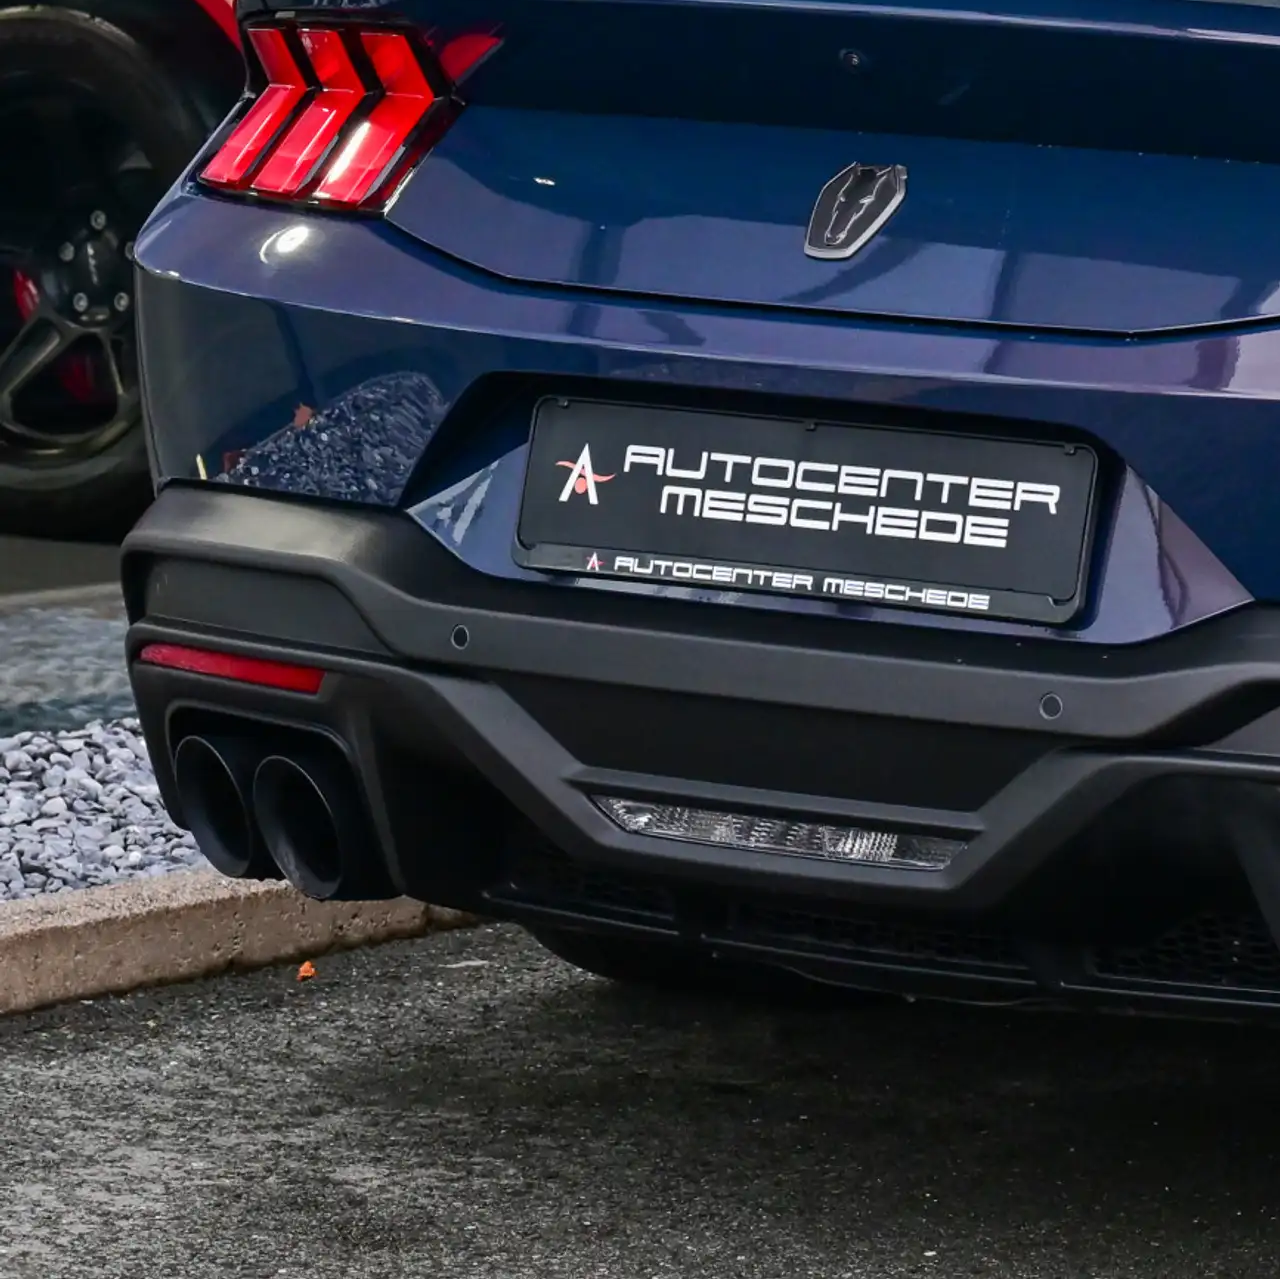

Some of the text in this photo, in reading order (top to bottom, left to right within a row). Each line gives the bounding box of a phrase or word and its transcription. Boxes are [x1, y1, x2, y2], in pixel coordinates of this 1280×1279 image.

[624, 444, 1061, 515] AUTOCENTER
[660, 485, 1009, 549] MESCHEDE
[614, 556, 991, 610] AUTOCENTER MESCHEDE
